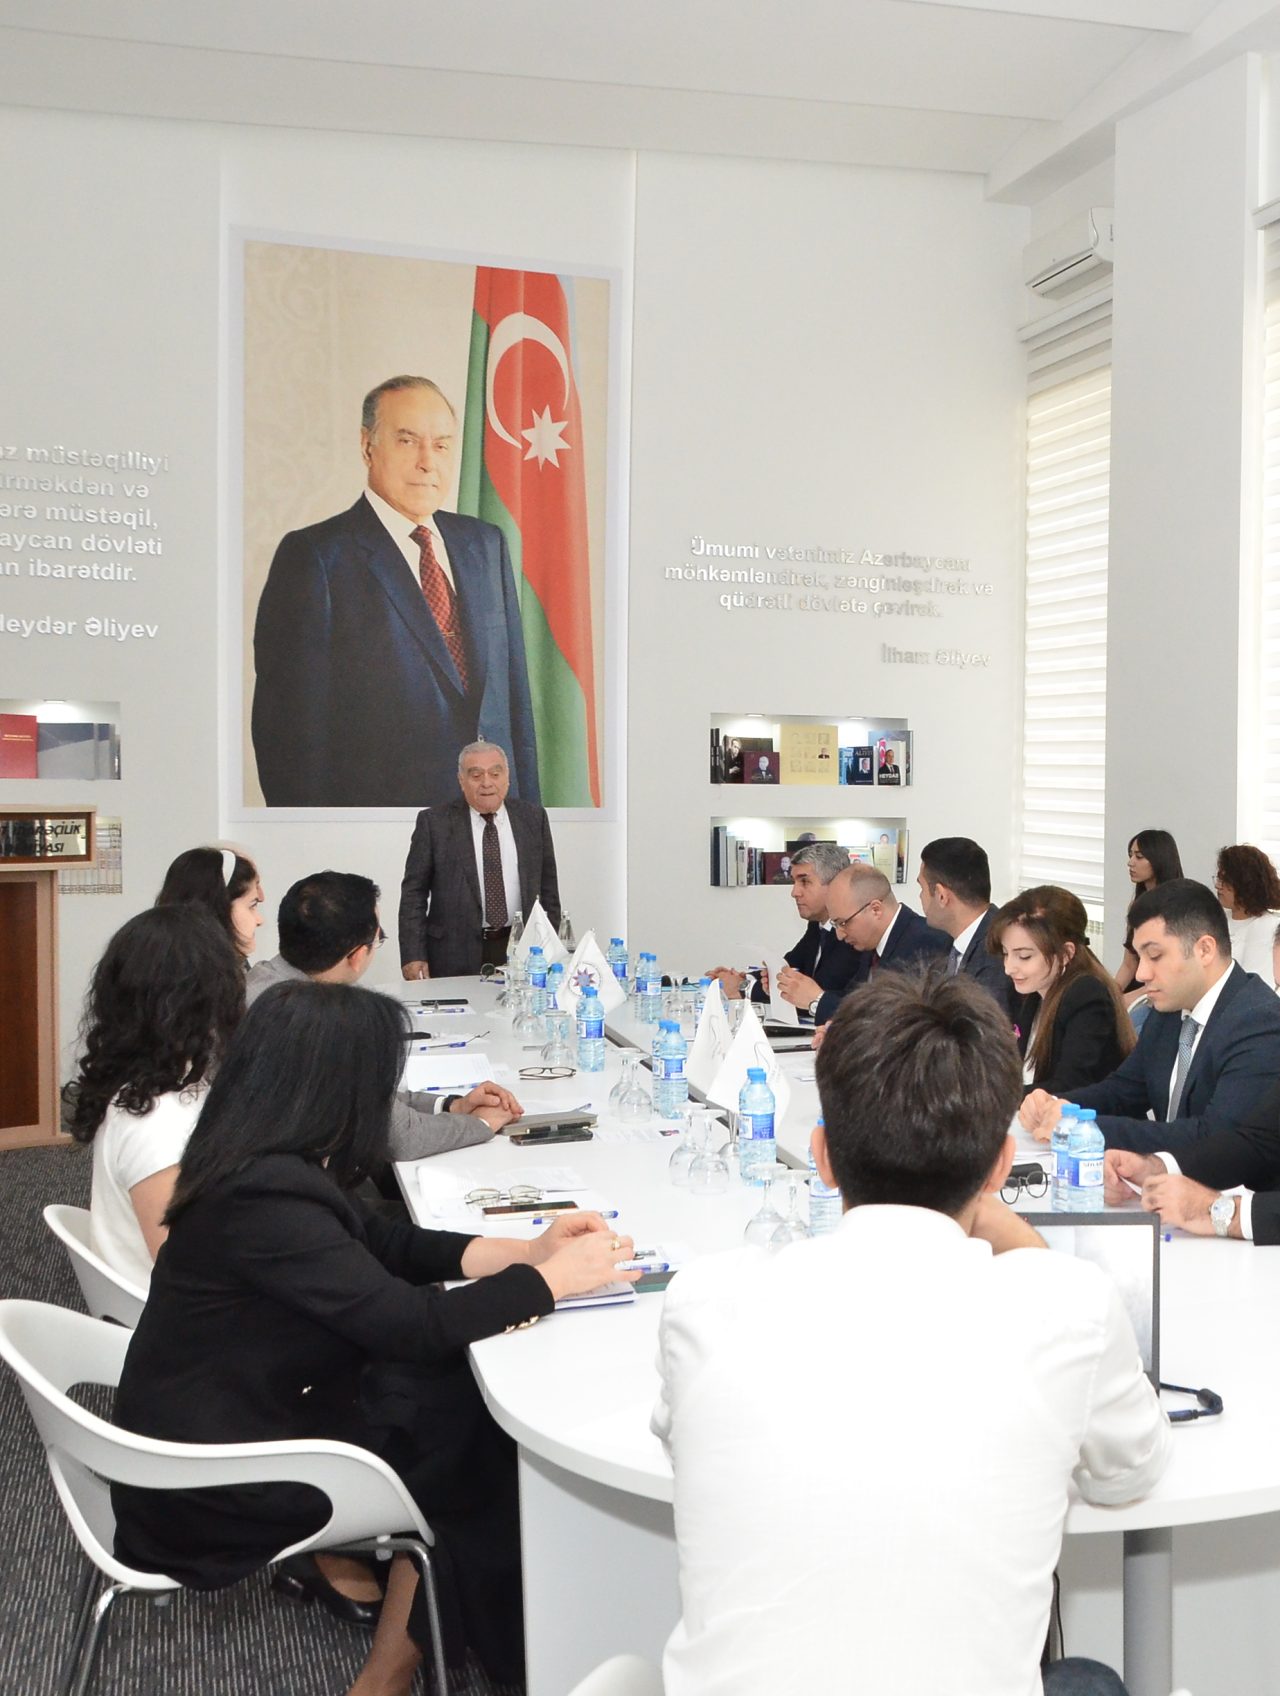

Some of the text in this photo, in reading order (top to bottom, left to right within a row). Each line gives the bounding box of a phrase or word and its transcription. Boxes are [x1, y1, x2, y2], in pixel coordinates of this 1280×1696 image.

[26, 446, 169, 476] müstəqilliyi
[123, 483, 149, 498] və
[46, 503, 158, 530] müstəqil,
[0, 532, 163, 555] aycan dövləti
[691, 536, 760, 559] Ümumi
[765, 545, 855, 564] vətənimiz
[29, 558, 138, 581] ibarətdir.
[974, 582, 994, 596] və
[85, 616, 160, 642] Əliyev
